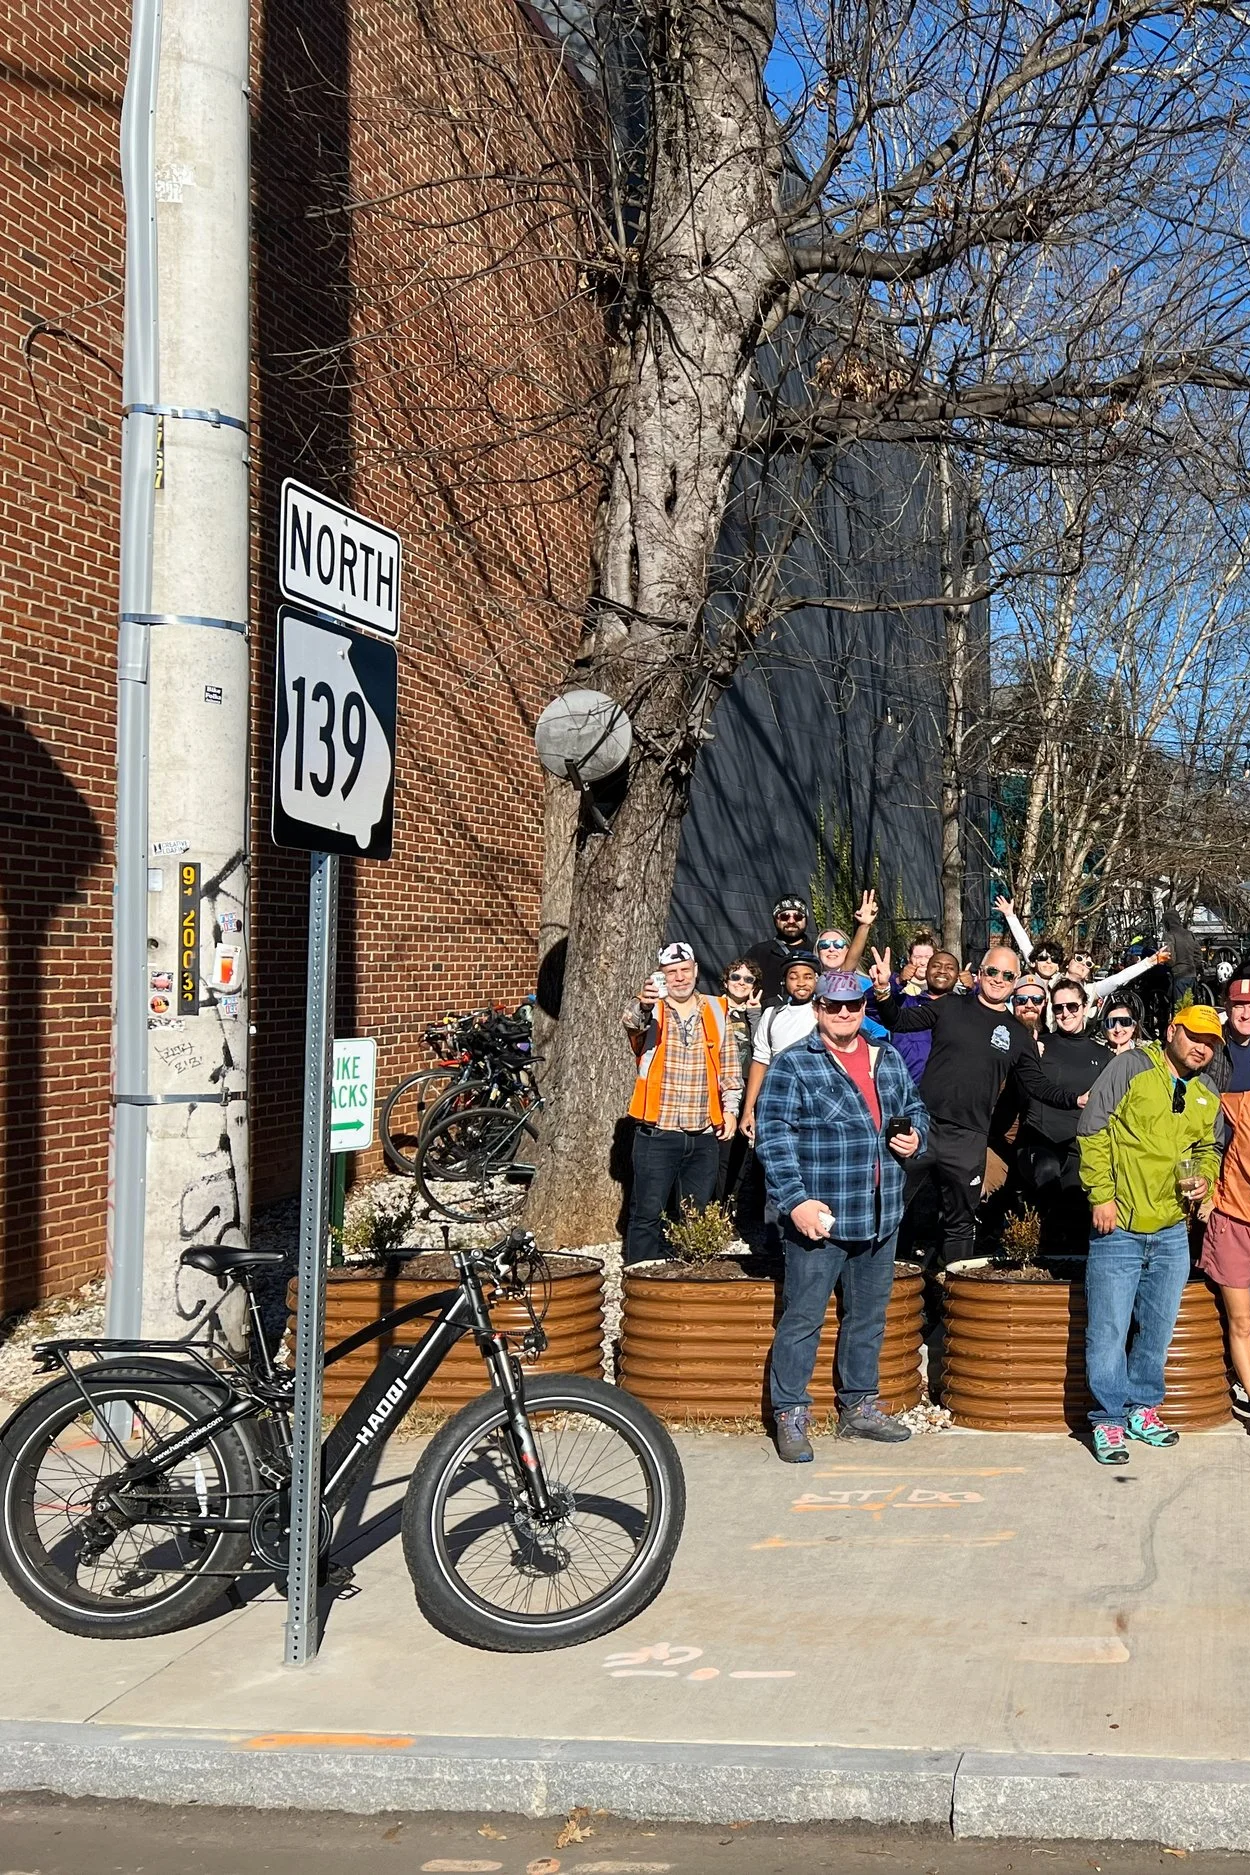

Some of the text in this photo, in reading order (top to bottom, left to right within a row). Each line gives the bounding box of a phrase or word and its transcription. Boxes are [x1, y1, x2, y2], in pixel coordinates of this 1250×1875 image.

[290, 503, 393, 612] NORTH
[292, 676, 366, 802] 139
[331, 1083, 368, 1109] ACKS
[333, 1056, 361, 1081] IKE
[150, 1416, 224, 1464] www.haoqiebike.com
[356, 1377, 408, 1446] HAOQI
